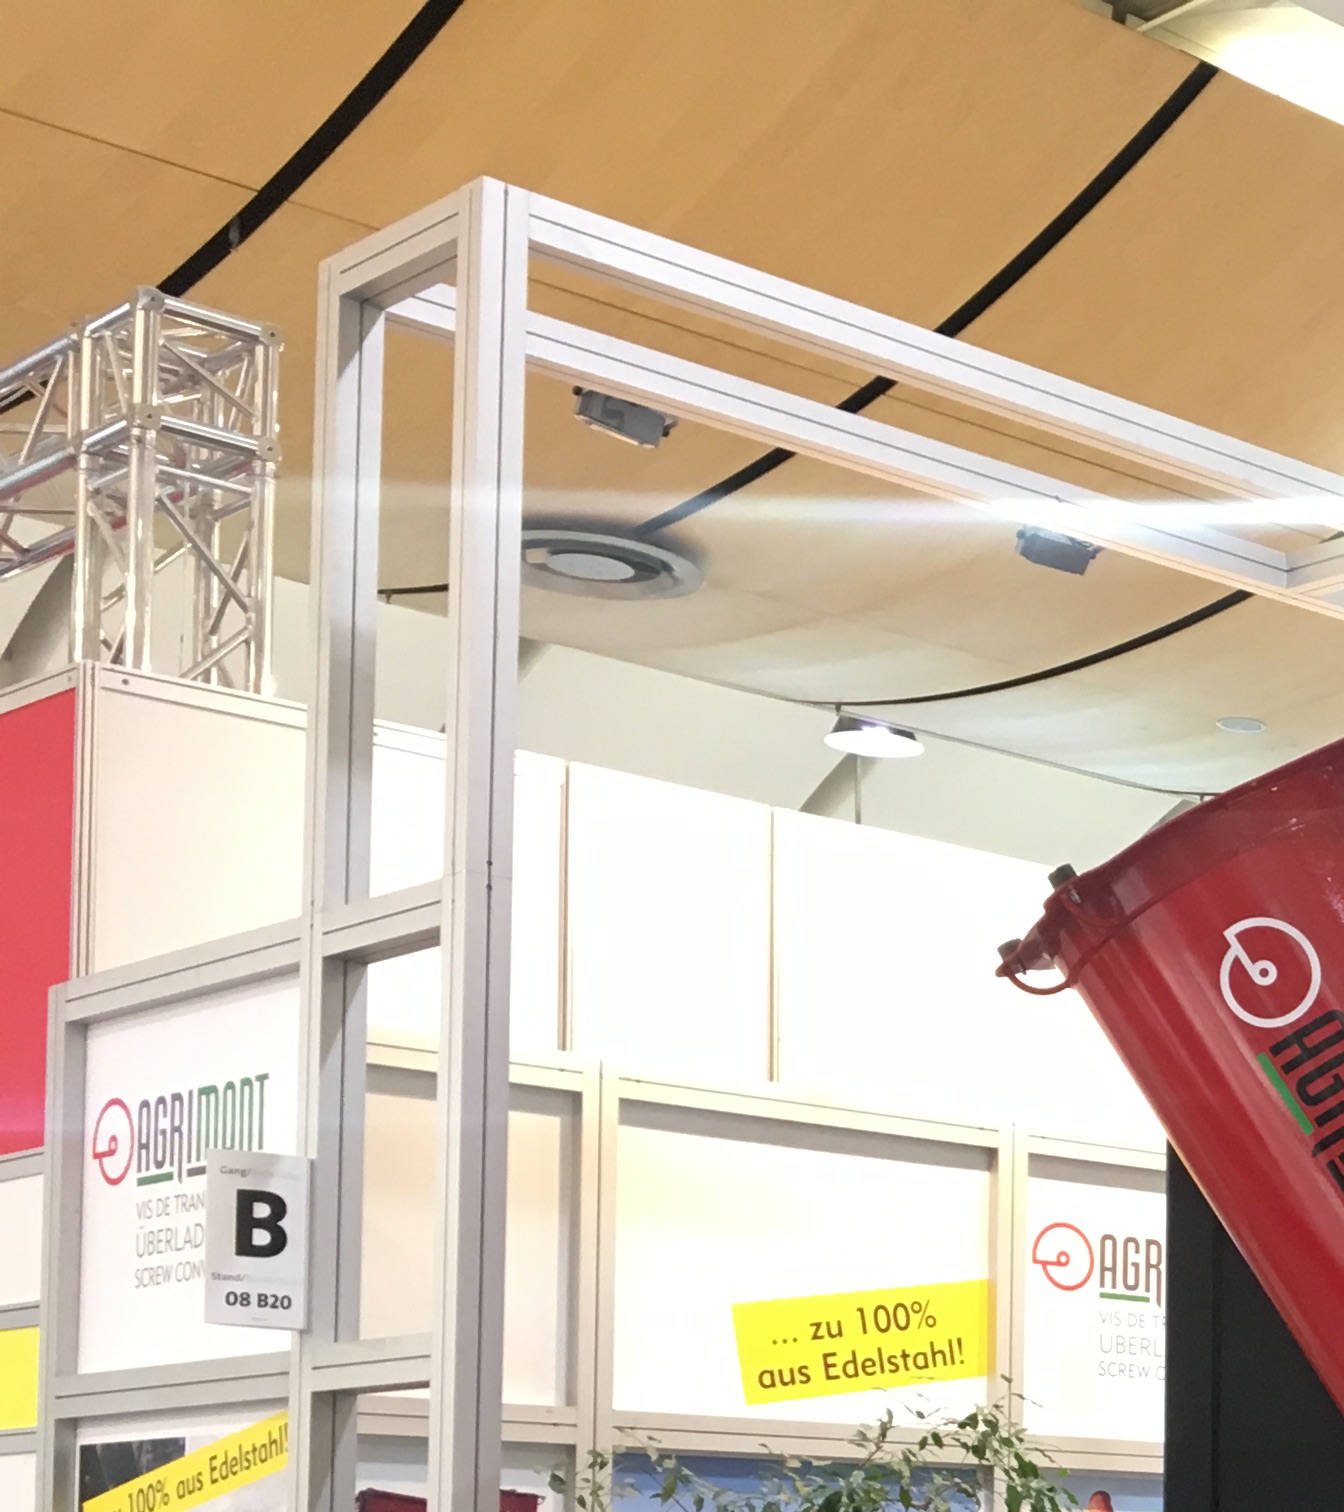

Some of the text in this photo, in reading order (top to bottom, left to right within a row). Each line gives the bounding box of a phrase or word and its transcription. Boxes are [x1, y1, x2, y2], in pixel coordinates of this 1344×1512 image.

[136, 1073, 269, 1184] AGRIMONT
[136, 1200, 152, 1220] VIS
[156, 1197, 170, 1216] DE
[235, 1188, 288, 1258] B
[134, 1263, 172, 1289] SCREW
[1099, 1233, 1162, 1308] AGR
[225, 1291, 292, 1310] 08 B20
[809, 1319, 843, 1341] zu
[856, 1299, 937, 1335] 100%
[1099, 1311, 1122, 1327] VIS
[1128, 1313, 1145, 1328] DE
[758, 1337, 965, 1389] aus Edelstahl!
[1099, 1361, 1150, 1379] SCREW
[176, 1472, 203, 1500] aus
[209, 1422, 288, 1486] Edelstahl!
